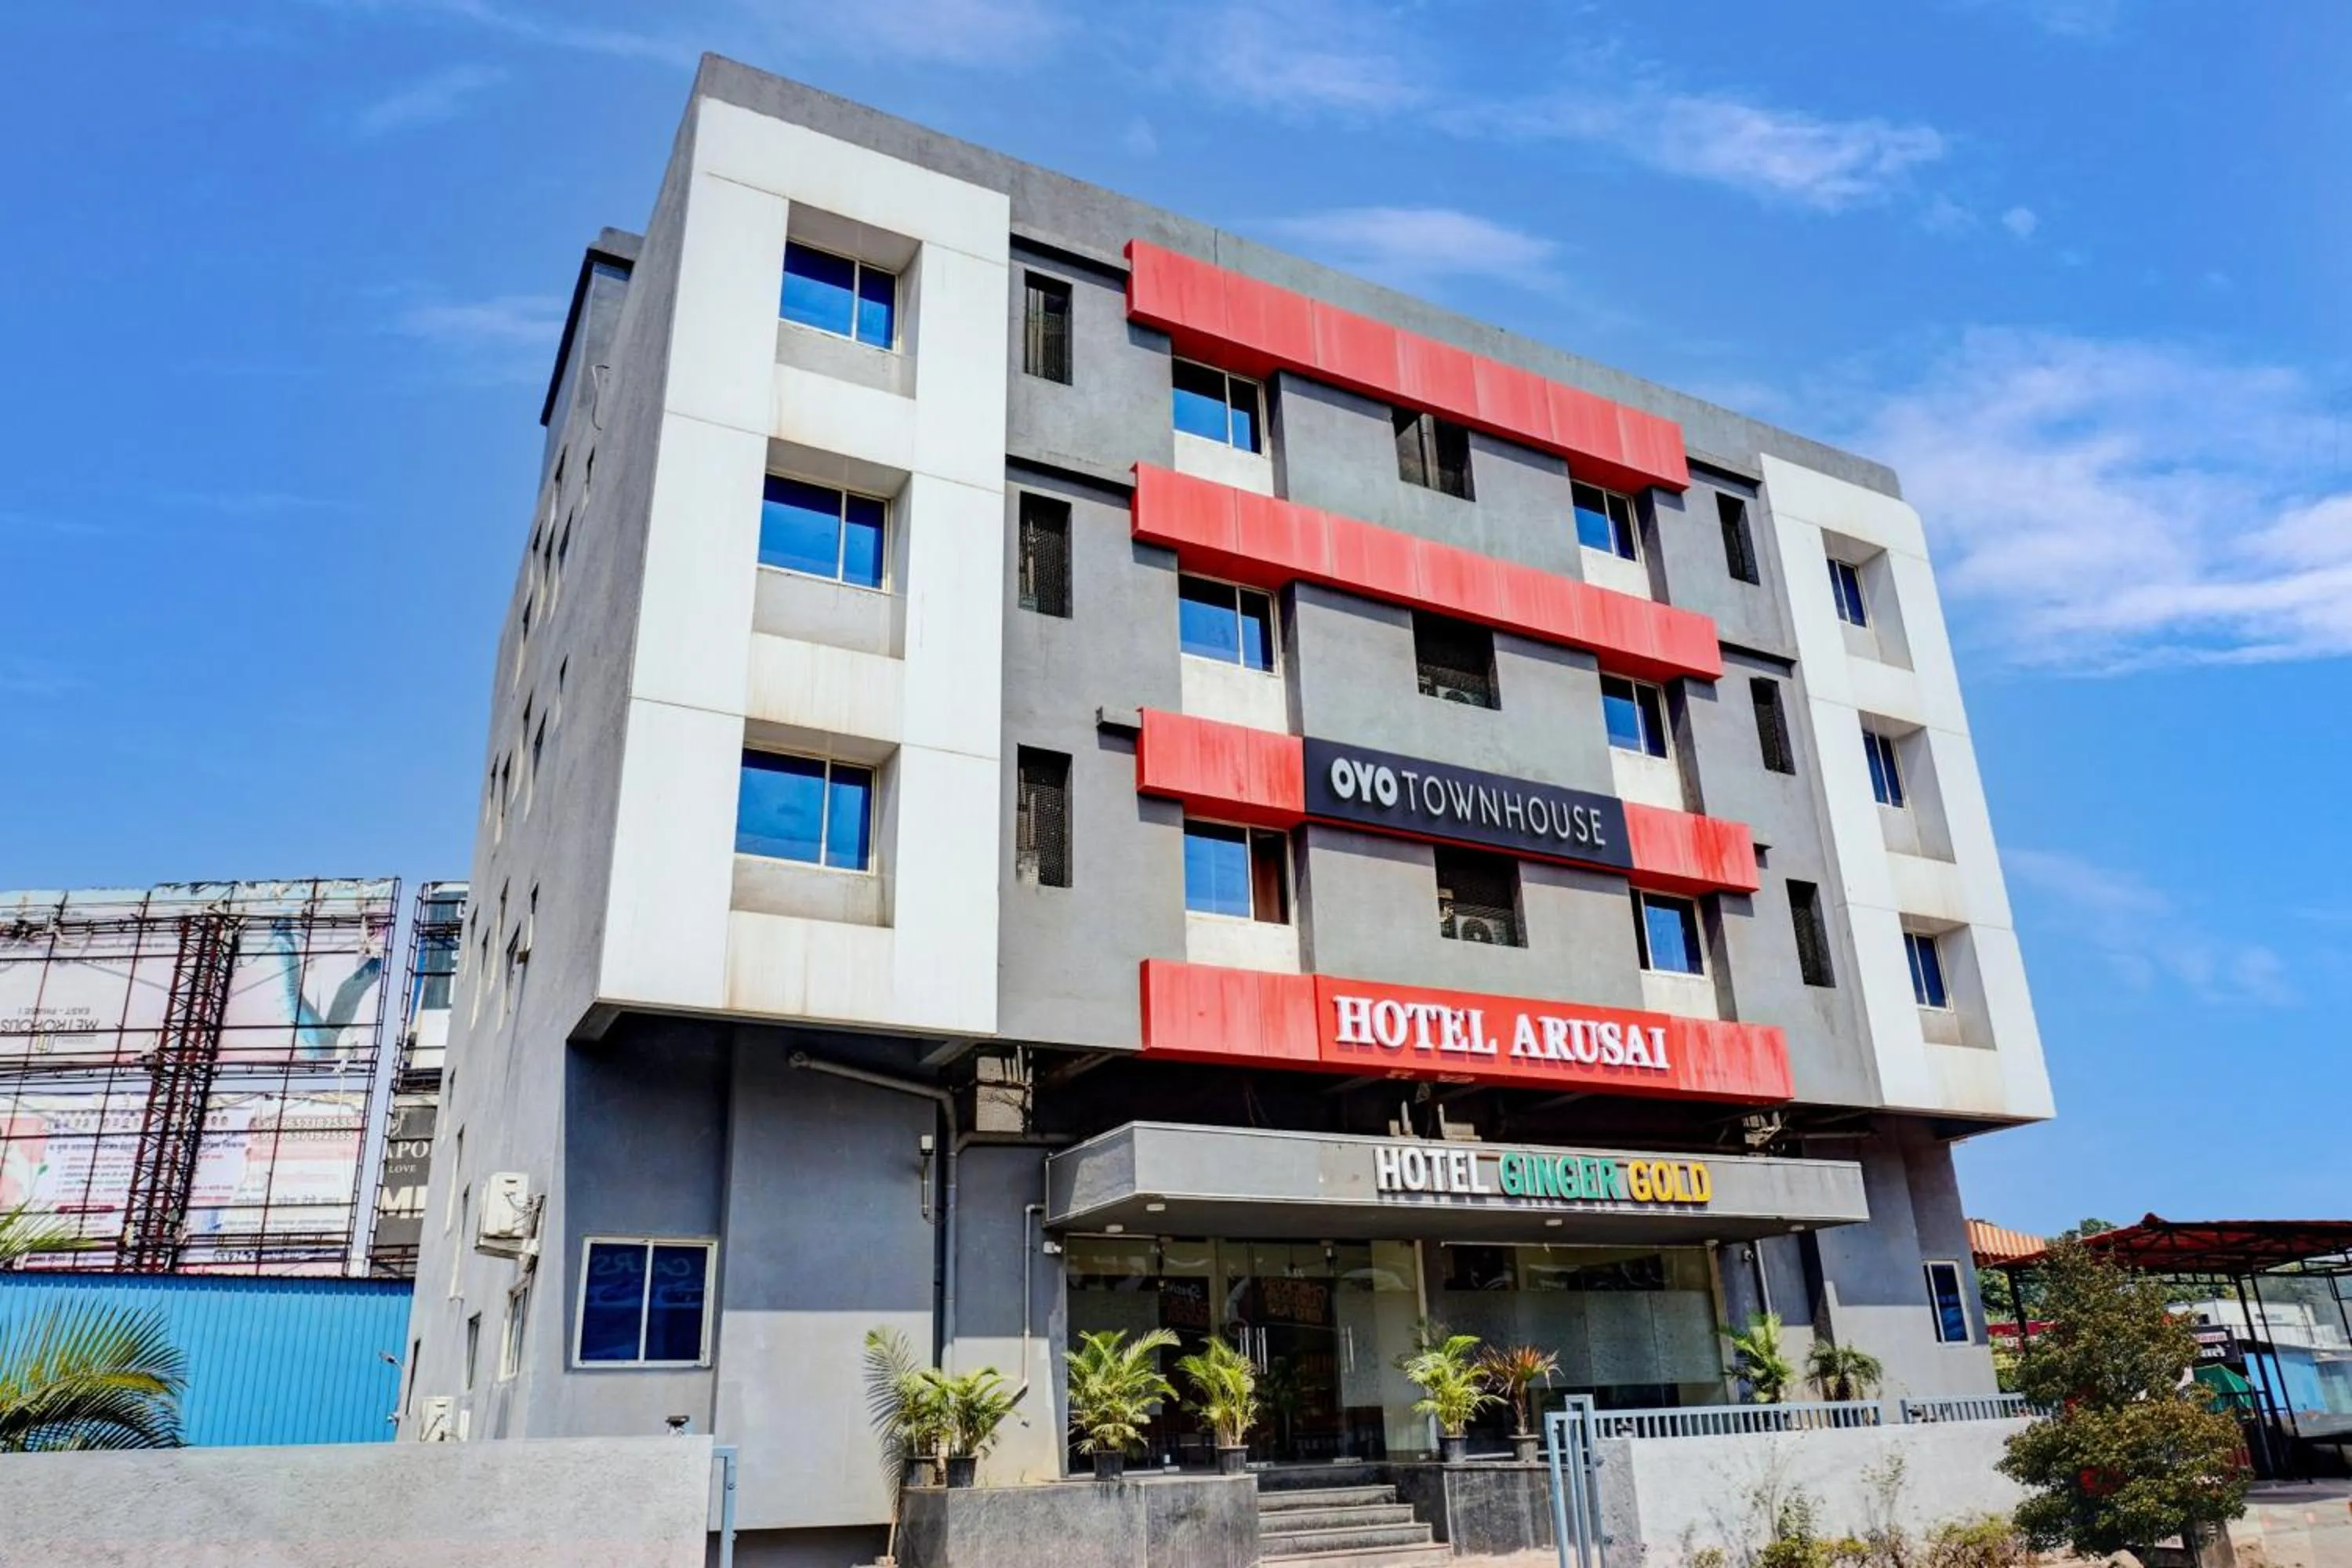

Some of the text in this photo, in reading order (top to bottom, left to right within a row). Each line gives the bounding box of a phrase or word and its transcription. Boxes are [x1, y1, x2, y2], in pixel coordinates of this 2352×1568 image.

[1331, 757, 1606, 846] OYO TOWNHOUSE
[1334, 995, 1669, 1069] HOTEL ARUSAI
[1375, 1147, 1711, 1203] HOTEL GINGER GOLD
